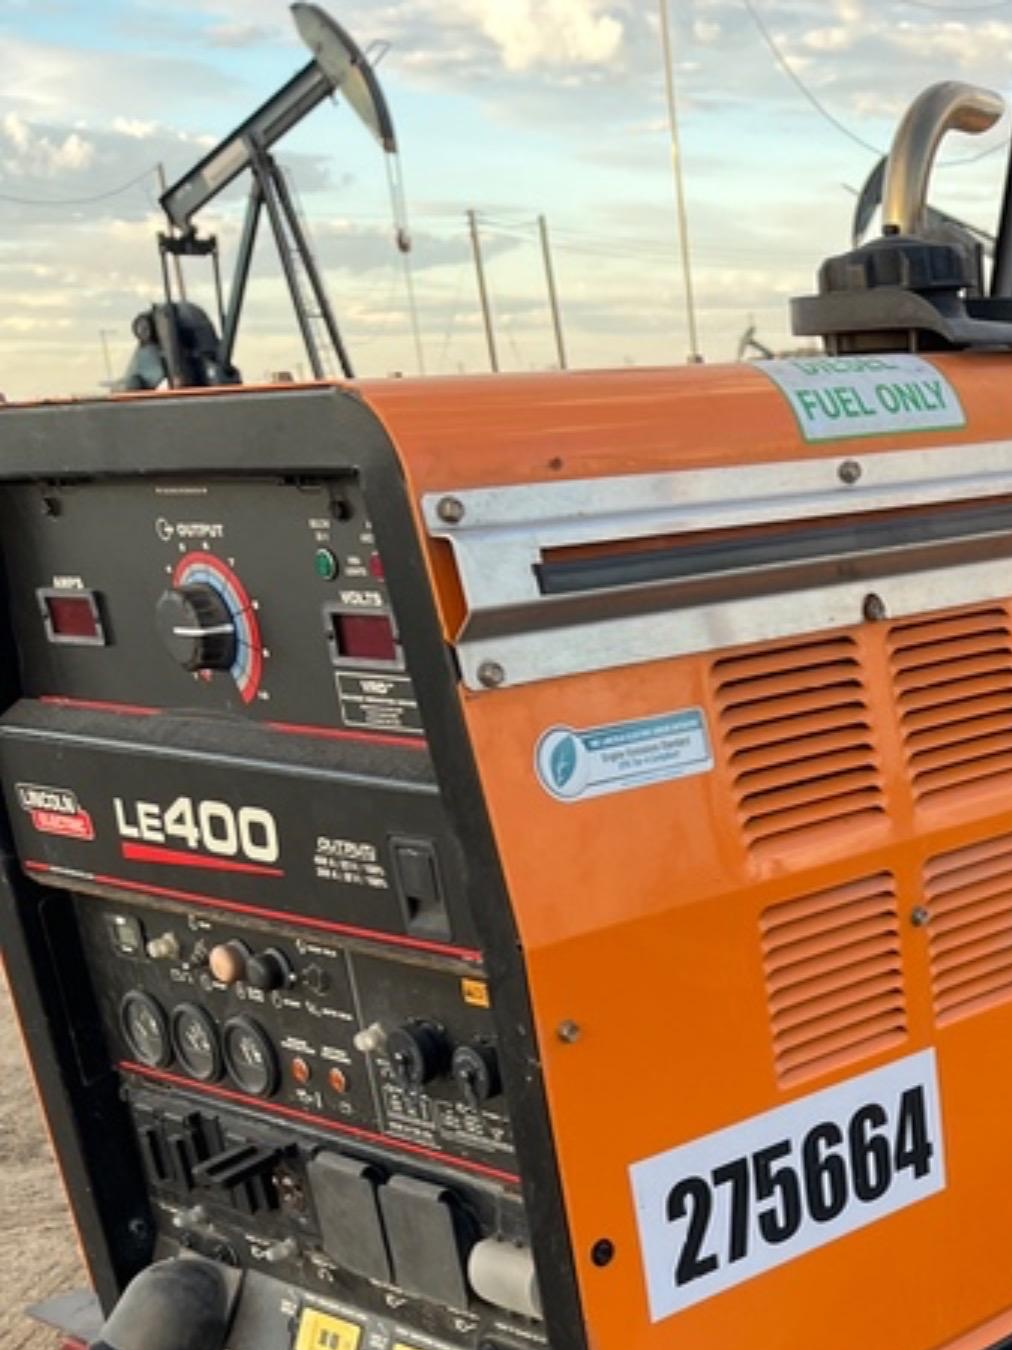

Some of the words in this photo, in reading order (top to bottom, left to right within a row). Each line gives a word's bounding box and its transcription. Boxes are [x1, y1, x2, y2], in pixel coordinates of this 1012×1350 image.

[795, 387, 876, 420] FUEL
[876, 380, 947, 413] ONLY
[112, 796, 279, 862] LE400
[666, 1083, 934, 1287] 275664
